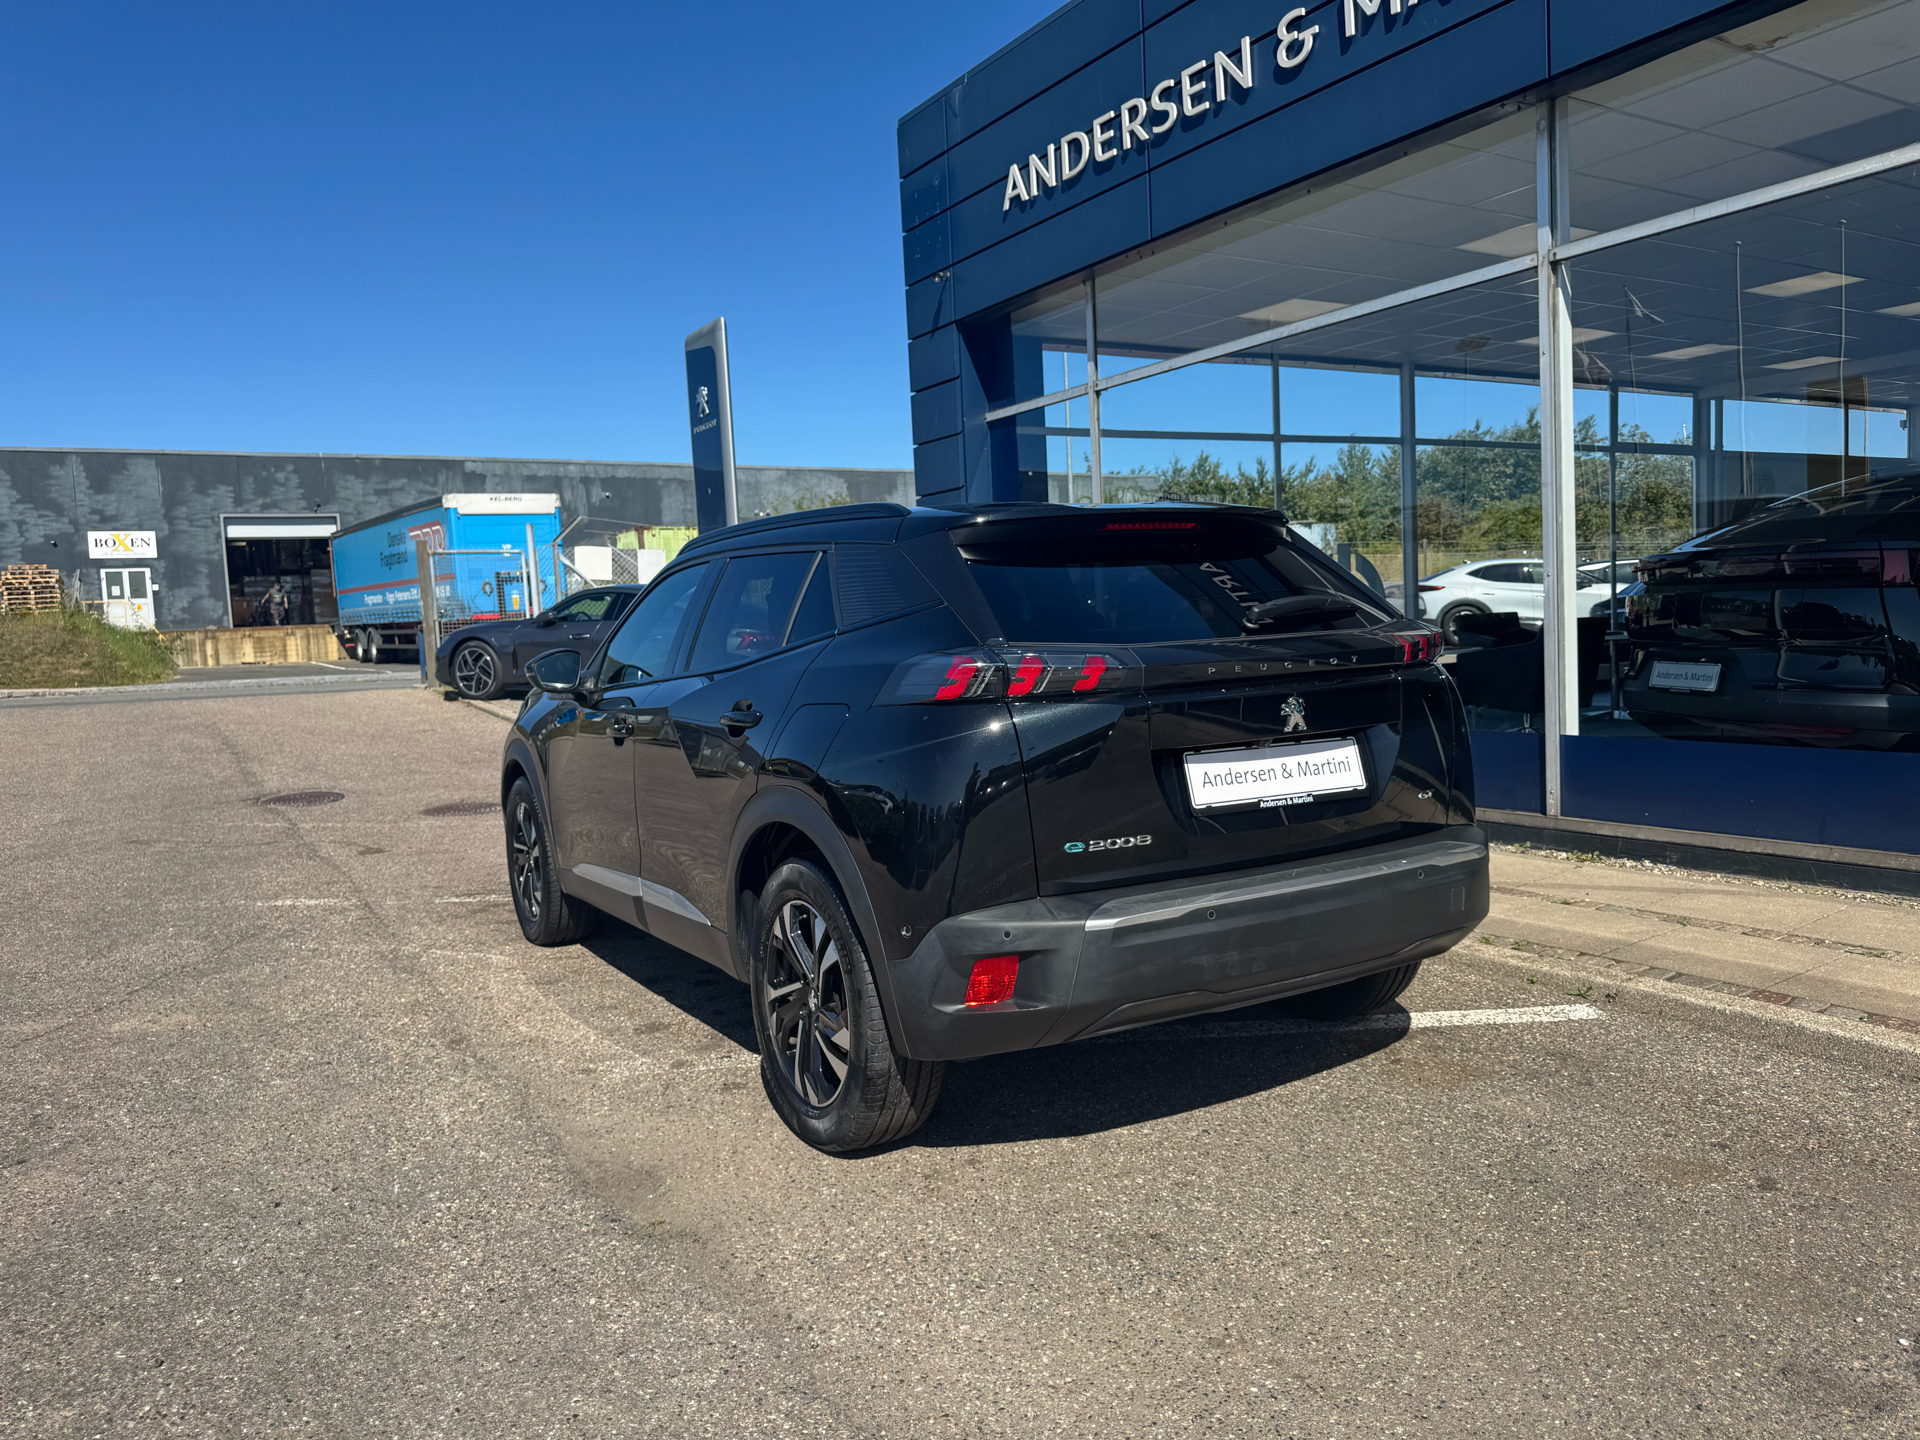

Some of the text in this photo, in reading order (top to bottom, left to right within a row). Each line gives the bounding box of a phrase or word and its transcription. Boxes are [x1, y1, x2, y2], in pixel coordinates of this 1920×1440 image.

[1002, 36, 1253, 211] ANDERSEN
[1276, 7, 1319, 68] &
[693, 419, 717, 434] PEUGEOT
[94, 533, 151, 552] BOXEN
[1208, 655, 1358, 674] PEUGEOT
[1656, 670, 1714, 682] Andersen & Martini
[1202, 756, 1351, 788] Andersen & Martini
[1260, 799, 1287, 808] Andersen
[1292, 795, 1313, 804] Martini
